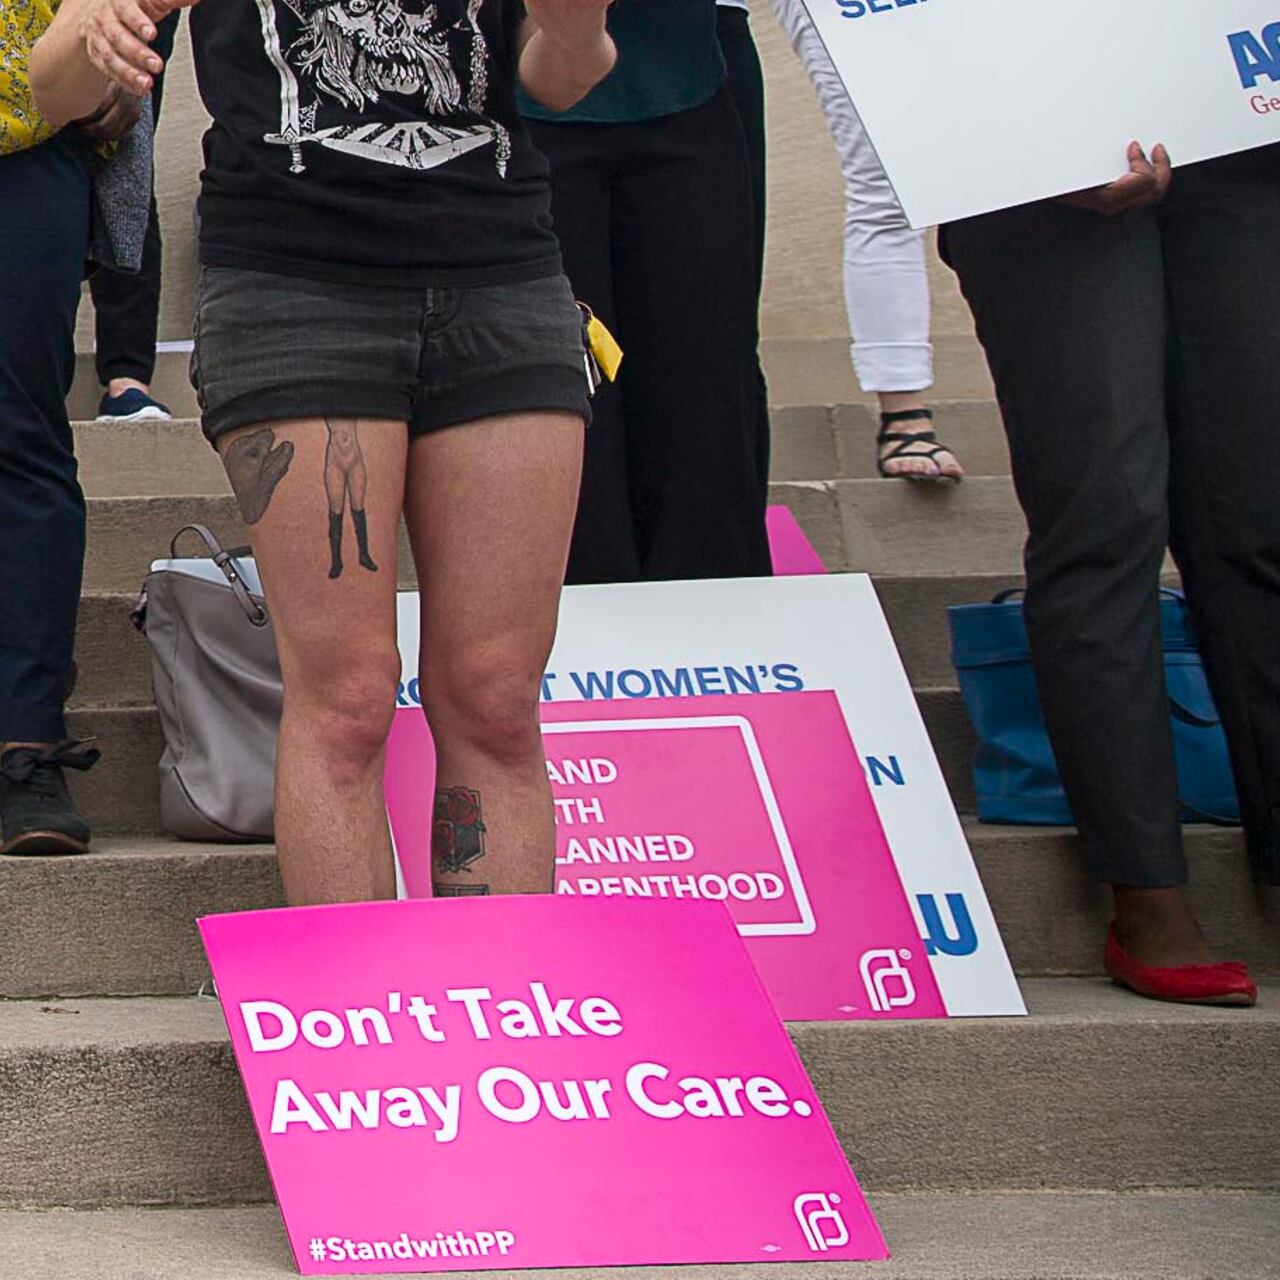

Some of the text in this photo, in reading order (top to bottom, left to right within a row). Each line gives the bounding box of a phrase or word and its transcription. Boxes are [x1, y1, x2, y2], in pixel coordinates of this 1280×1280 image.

[570, 663, 804, 701] WOMEN'S
[239, 982, 624, 1053] Don't Take
[269, 1062, 813, 1143] Away Our Care.
[309, 1230, 516, 1264] #StandwithPP
